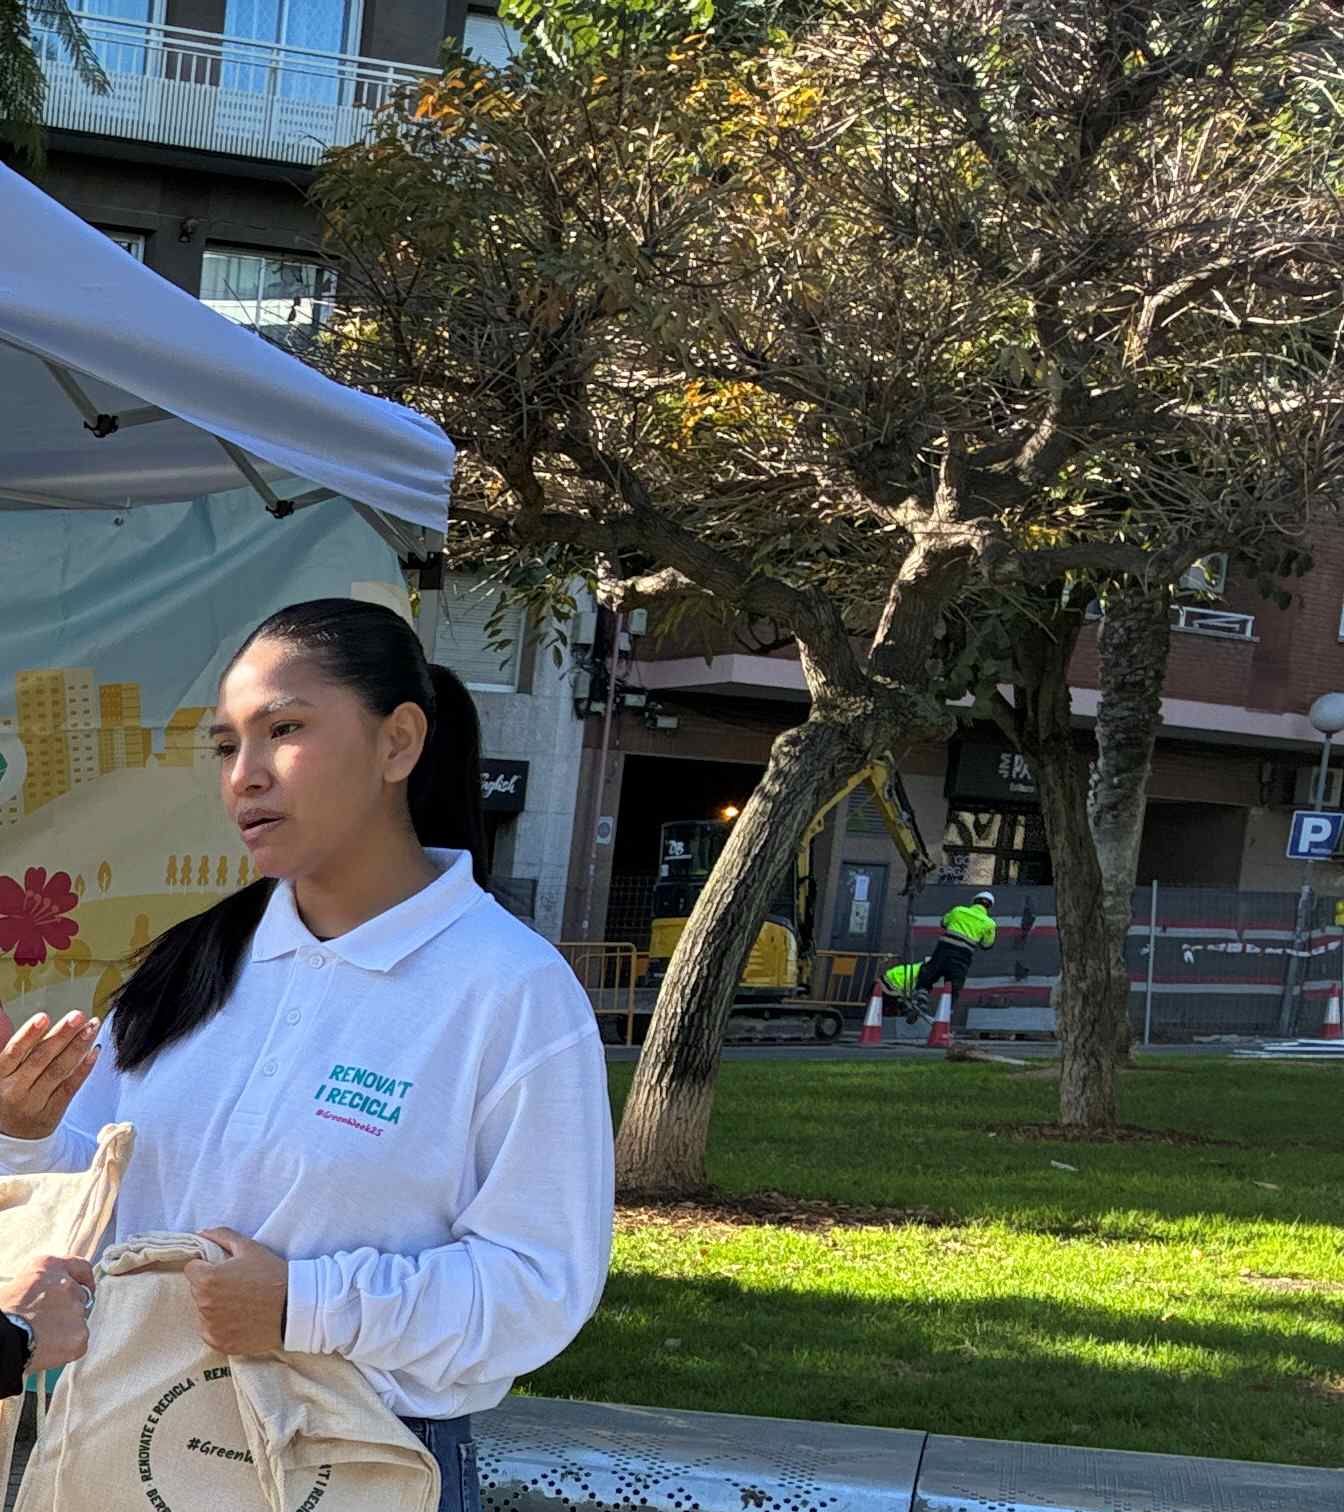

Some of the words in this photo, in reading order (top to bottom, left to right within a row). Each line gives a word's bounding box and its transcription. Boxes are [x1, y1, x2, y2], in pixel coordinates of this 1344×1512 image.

[1298, 817, 1332, 853] P
[329, 1064, 413, 1098] RENOVA'T
[314, 1084, 327, 1100] I
[325, 1087, 402, 1125] RECICLA
[153, 1378, 195, 1416] RECICLA
[148, 1414, 160, 1424] E
[138, 1425, 154, 1482] RENOVATE
